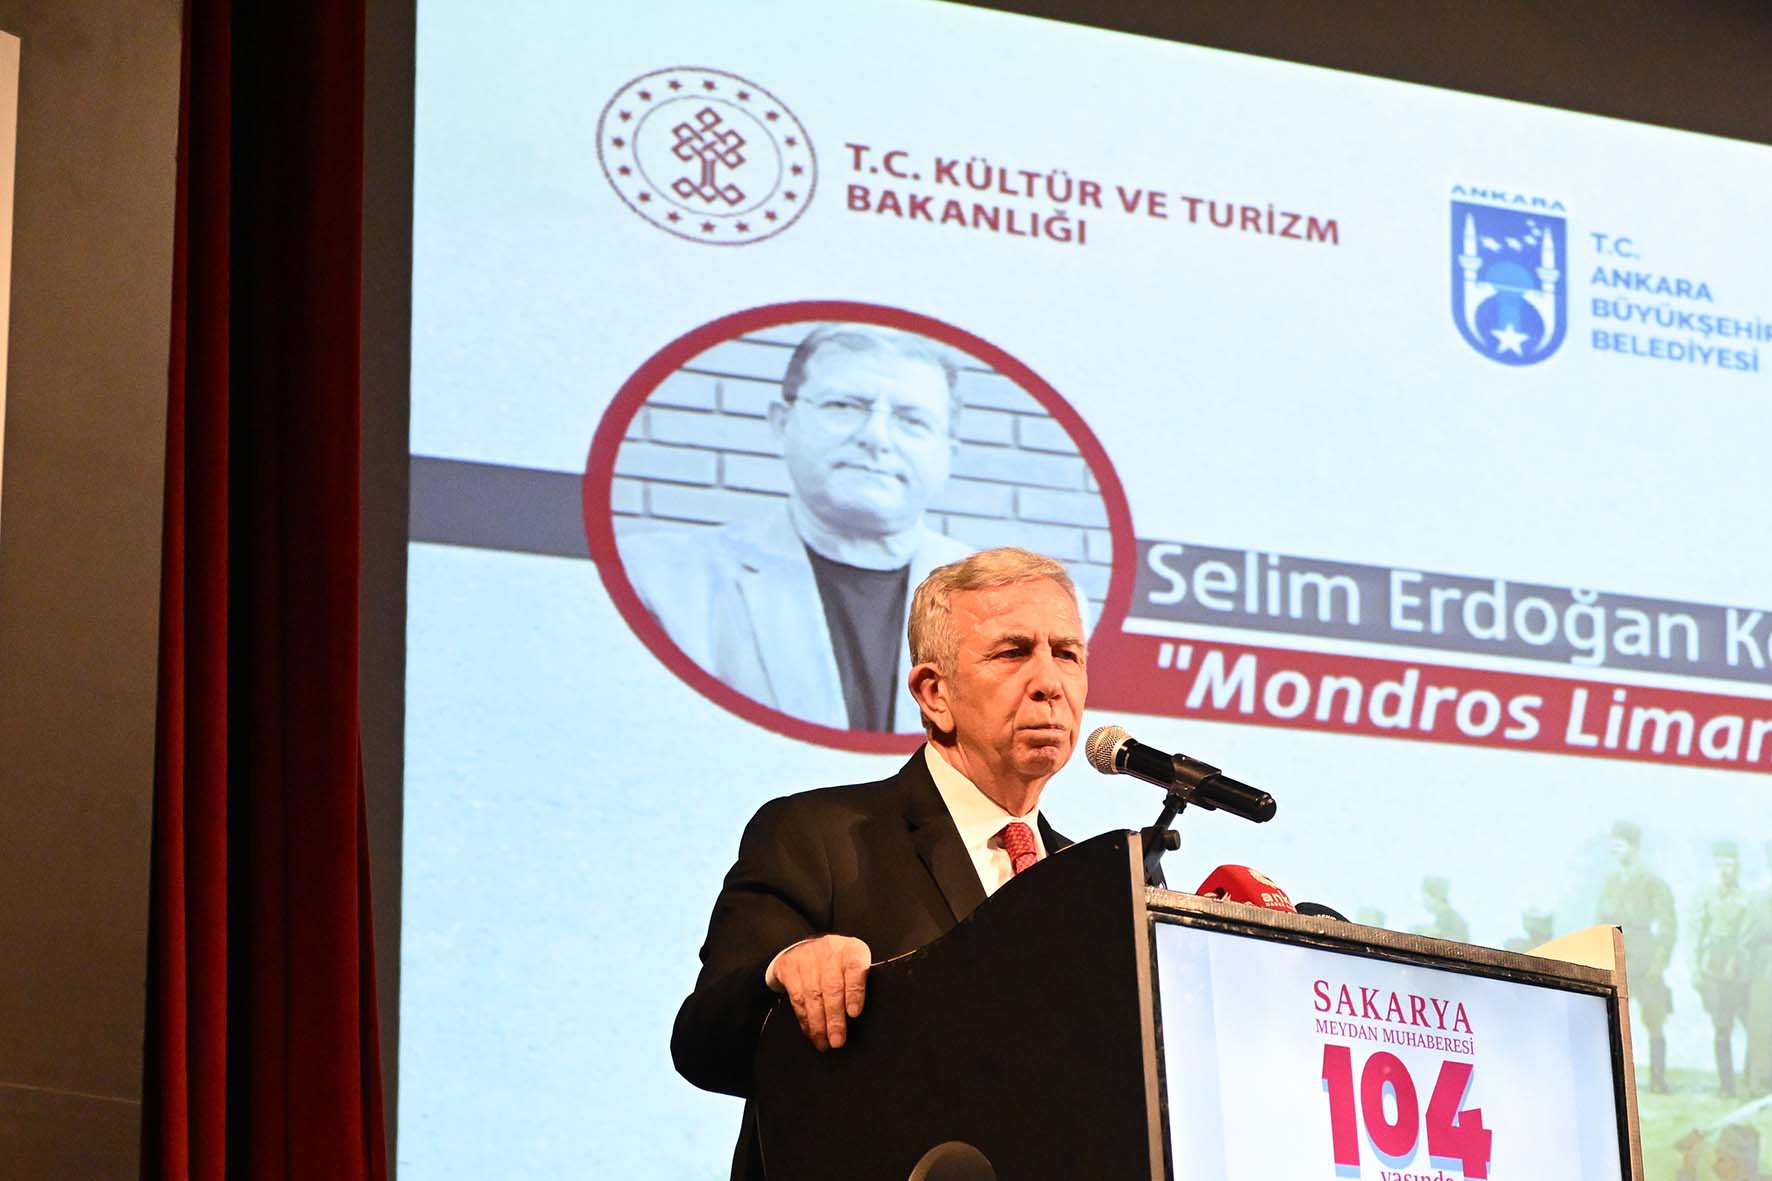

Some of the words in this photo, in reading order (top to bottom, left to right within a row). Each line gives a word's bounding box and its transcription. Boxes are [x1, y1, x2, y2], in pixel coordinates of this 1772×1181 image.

[845, 143, 921, 181] T.C.
[935, 155, 1103, 209] KÜLTÜR
[1116, 185, 1168, 220] VE
[1180, 195, 1341, 246] TURİZM
[846, 184, 1087, 245] BAKANLIĞI
[1590, 232, 1641, 260] T.C.
[1591, 266, 1714, 302] ANKARA
[1592, 330, 1760, 372] BELEDİYESİ
[1147, 542, 1361, 626] Selim
[1390, 569, 1699, 667] Erdoğan
[1156, 643, 1543, 742] "Mondros
[1313, 979, 1474, 1034] SAKARYA
[1315, 1019, 1378, 1041] MEYDAN
[1383, 1028, 1475, 1055] MUHABERESİ
[1322, 1043, 1492, 1181] 104
